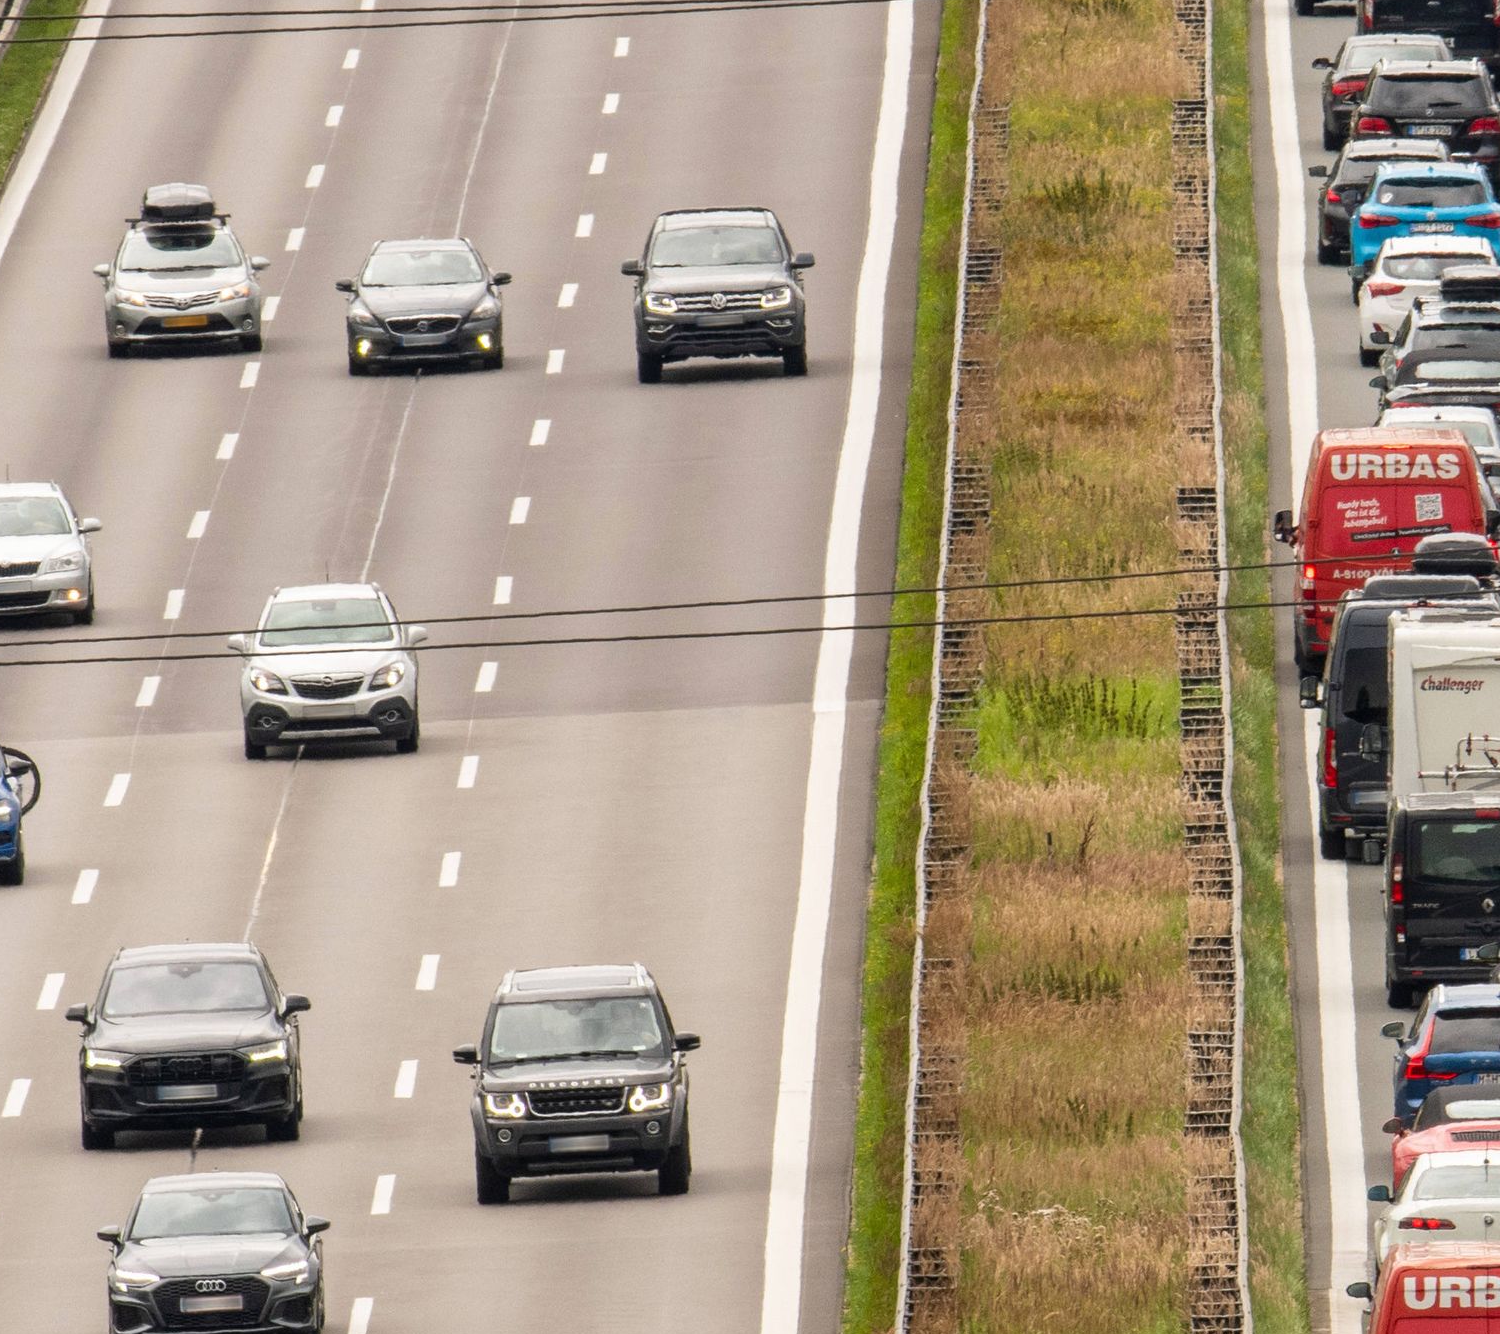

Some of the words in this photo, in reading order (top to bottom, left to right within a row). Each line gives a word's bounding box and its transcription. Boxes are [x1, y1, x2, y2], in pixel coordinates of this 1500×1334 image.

[1330, 453, 1461, 481] URBAS
[1420, 675, 1485, 695] Challenger
[529, 1078, 625, 1088] DISCOVERY
